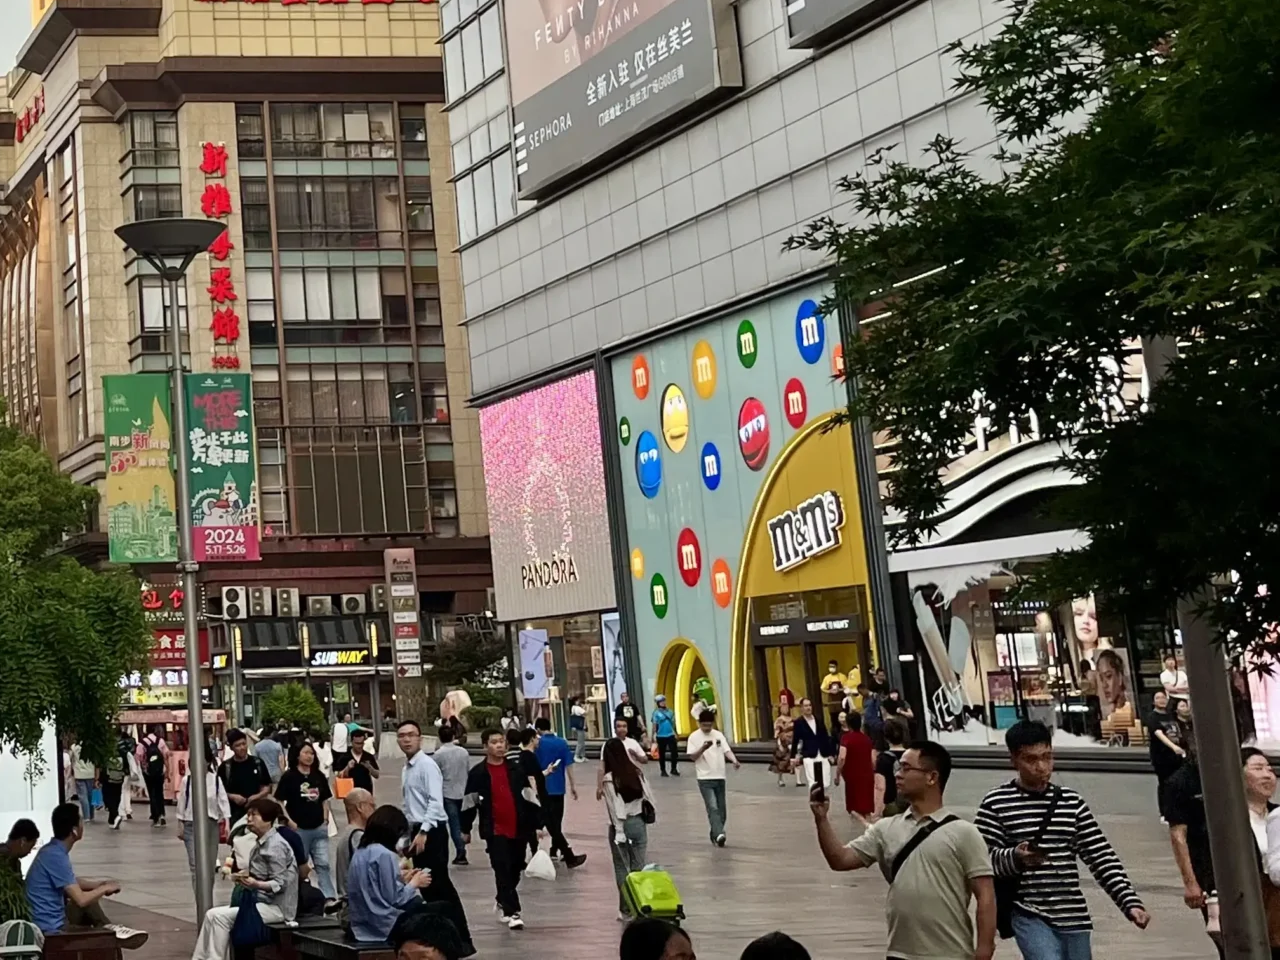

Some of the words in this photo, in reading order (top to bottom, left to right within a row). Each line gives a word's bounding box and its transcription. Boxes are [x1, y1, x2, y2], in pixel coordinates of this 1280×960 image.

[564, 45, 578, 64] BY
[584, 2, 640, 51] RIHANNA
[586, 59, 630, 107] 全新入驻
[633, 17, 694, 77] 仅在丝芙兰
[528, 112, 573, 151] SEPHORA
[740, 332, 755, 356] m
[801, 316, 820, 347] m
[635, 367, 647, 388] m
[696, 355, 713, 384] m
[788, 390, 804, 415] m
[704, 454, 718, 477] m
[204, 528, 245, 544] 2024
[682, 543, 698, 571] m
[522, 554, 579, 590] PANDORA
[714, 572, 729, 594] m
[653, 584, 666, 606] m
[311, 649, 369, 666] SUBWAY
